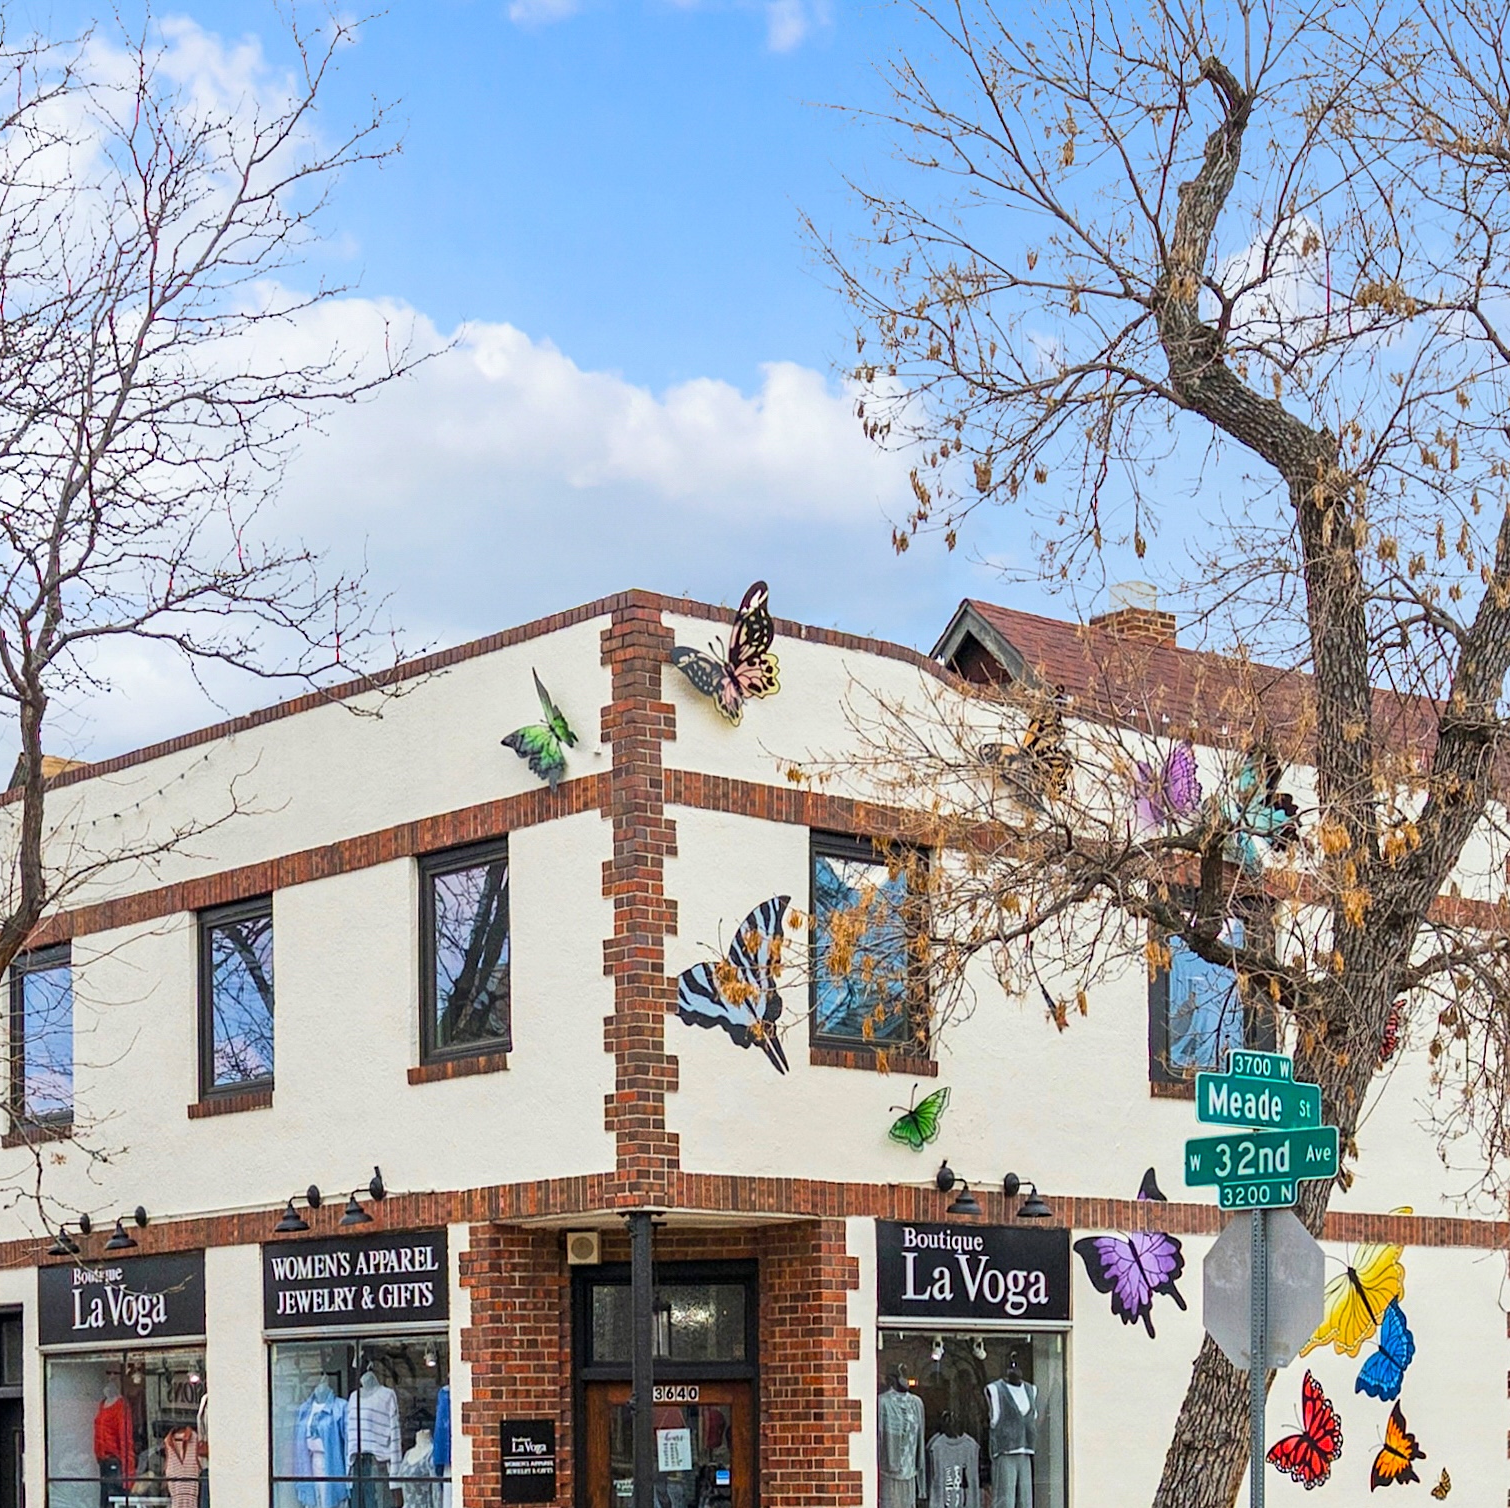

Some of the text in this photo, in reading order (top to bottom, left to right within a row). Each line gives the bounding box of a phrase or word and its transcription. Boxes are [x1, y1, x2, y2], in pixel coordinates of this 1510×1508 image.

[1235, 1055, 1290, 1079] 3700 W
[1208, 1082, 1311, 1122] Meade St
[1190, 1139, 1332, 1178] W 32nd Ave
[1223, 1184, 1292, 1206] 3200 N
[902, 1227, 984, 1254] Boutique
[72, 1267, 124, 1285] Boutique
[271, 1246, 439, 1281] WOMEN'S APPAREL
[276, 1282, 434, 1315] JEWELRY & GIFTS
[901, 1252, 1050, 1316] La Voga
[71, 1284, 168, 1336] La Voga
[654, 1387, 698, 1400] 3640
[511, 1441, 547, 1455] La Voga
